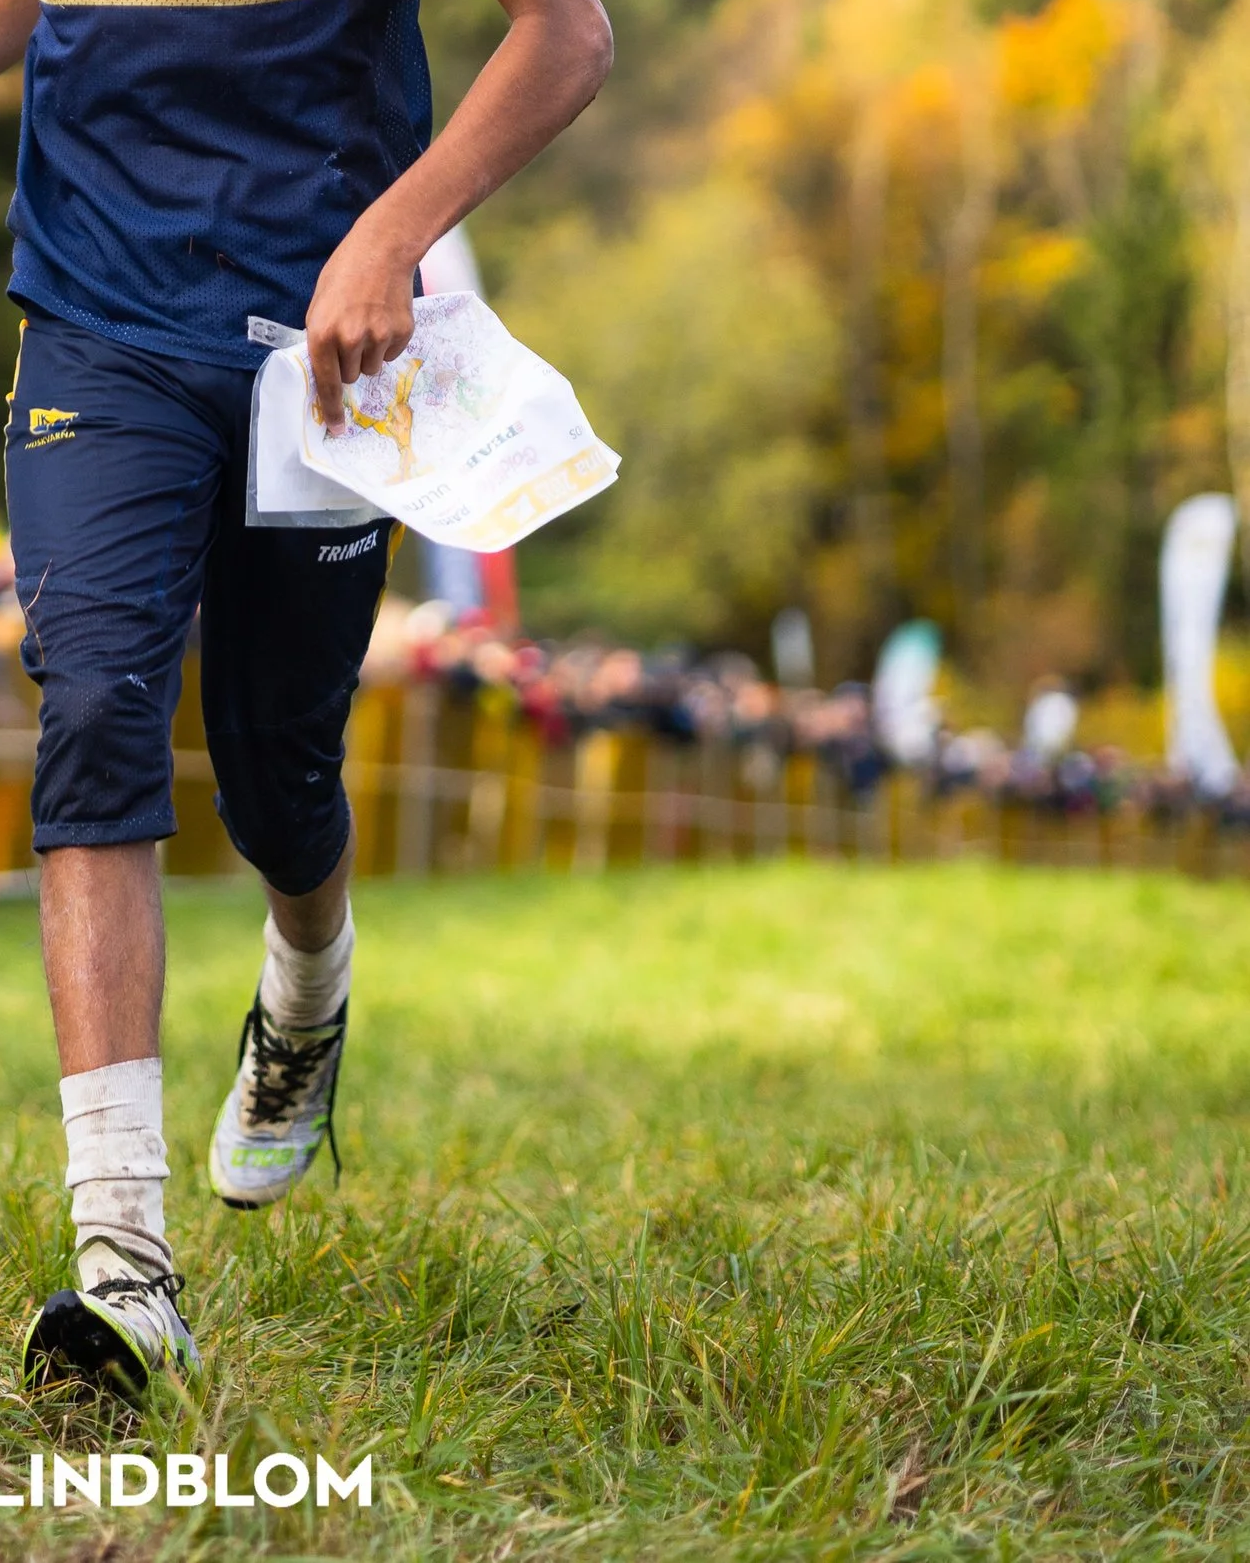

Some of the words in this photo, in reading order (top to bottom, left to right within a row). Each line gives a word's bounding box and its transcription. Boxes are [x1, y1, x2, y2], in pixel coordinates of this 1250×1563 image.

[24, 430, 76, 450] HUSKVARNA
[466, 423, 519, 469] PEAB
[317, 529, 379, 562] TRIMTEX
